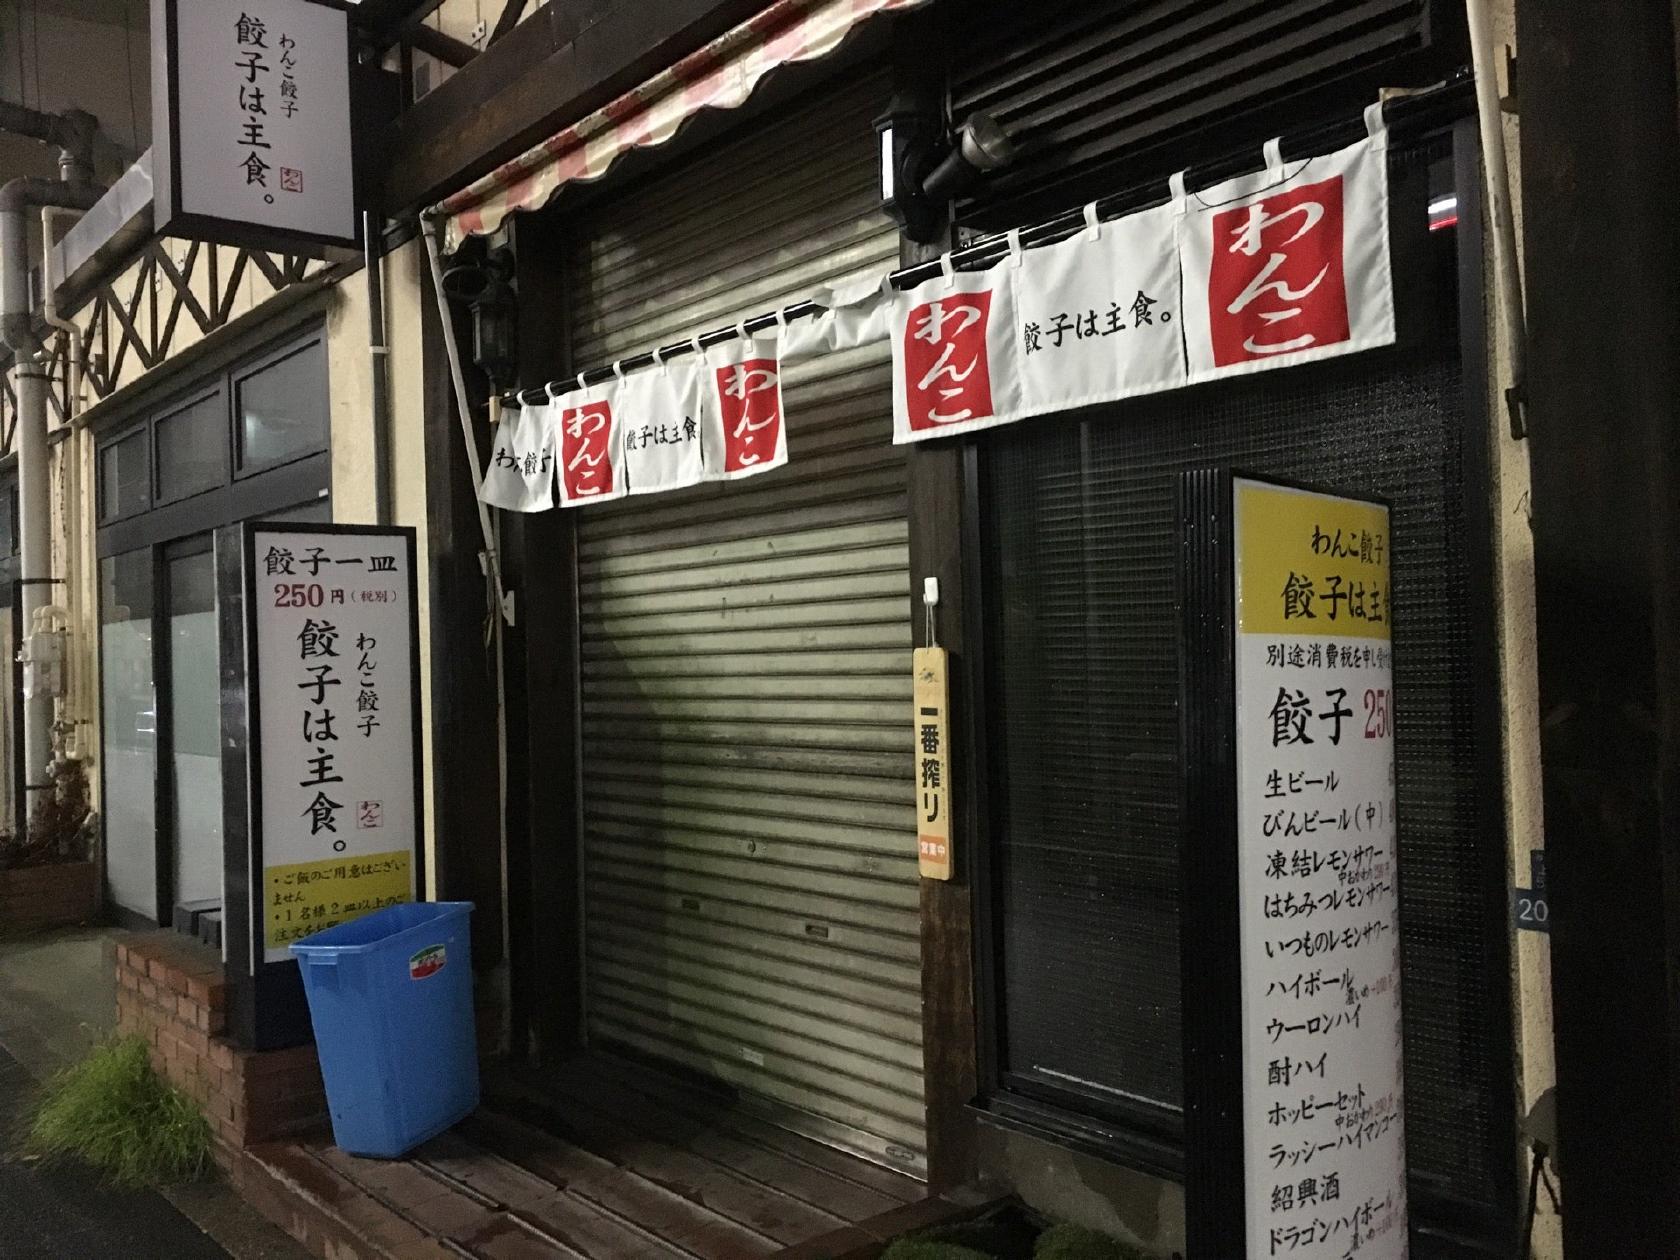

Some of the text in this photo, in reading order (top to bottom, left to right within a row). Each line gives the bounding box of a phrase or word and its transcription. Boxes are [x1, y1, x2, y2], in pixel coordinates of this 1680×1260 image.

[279, 33, 299, 118] わんこ餃子
[234, 12, 274, 205] 餃子は主食。
[1226, 201, 1329, 354] わんこ
[1023, 290, 1172, 355] 餃子は主食。
[914, 302, 980, 424] わんこ
[724, 365, 777, 465] わんこ
[566, 409, 605, 495] わんこ
[263, 546, 398, 576] 餃子一皿
[1311, 525, 1383, 565] わんこ餃子
[356, 633, 380, 737] わんこ餃子
[297, 618, 346, 851] 餃子は主食。
[1268, 687, 1353, 747] 餃子
[920, 707, 940, 823] 一番搾り
[1264, 769, 1340, 799] 生ビール
[1265, 845, 1383, 879] 凍結レモンサワー
[273, 892, 305, 906] ません
[1264, 882, 1390, 919] はちみつレモンサワー
[1519, 898, 1549, 922] 20
[1265, 921, 1389, 958] いつものレモンサワー
[1266, 968, 1354, 999] ハイボール
[1266, 1004, 1361, 1044] ウーロンハイ
[1268, 1052, 1327, 1087] 酎ハイ
[1268, 1083, 1365, 1126] ホッピーセット
[1271, 1171, 1340, 1212] 紹興酒
